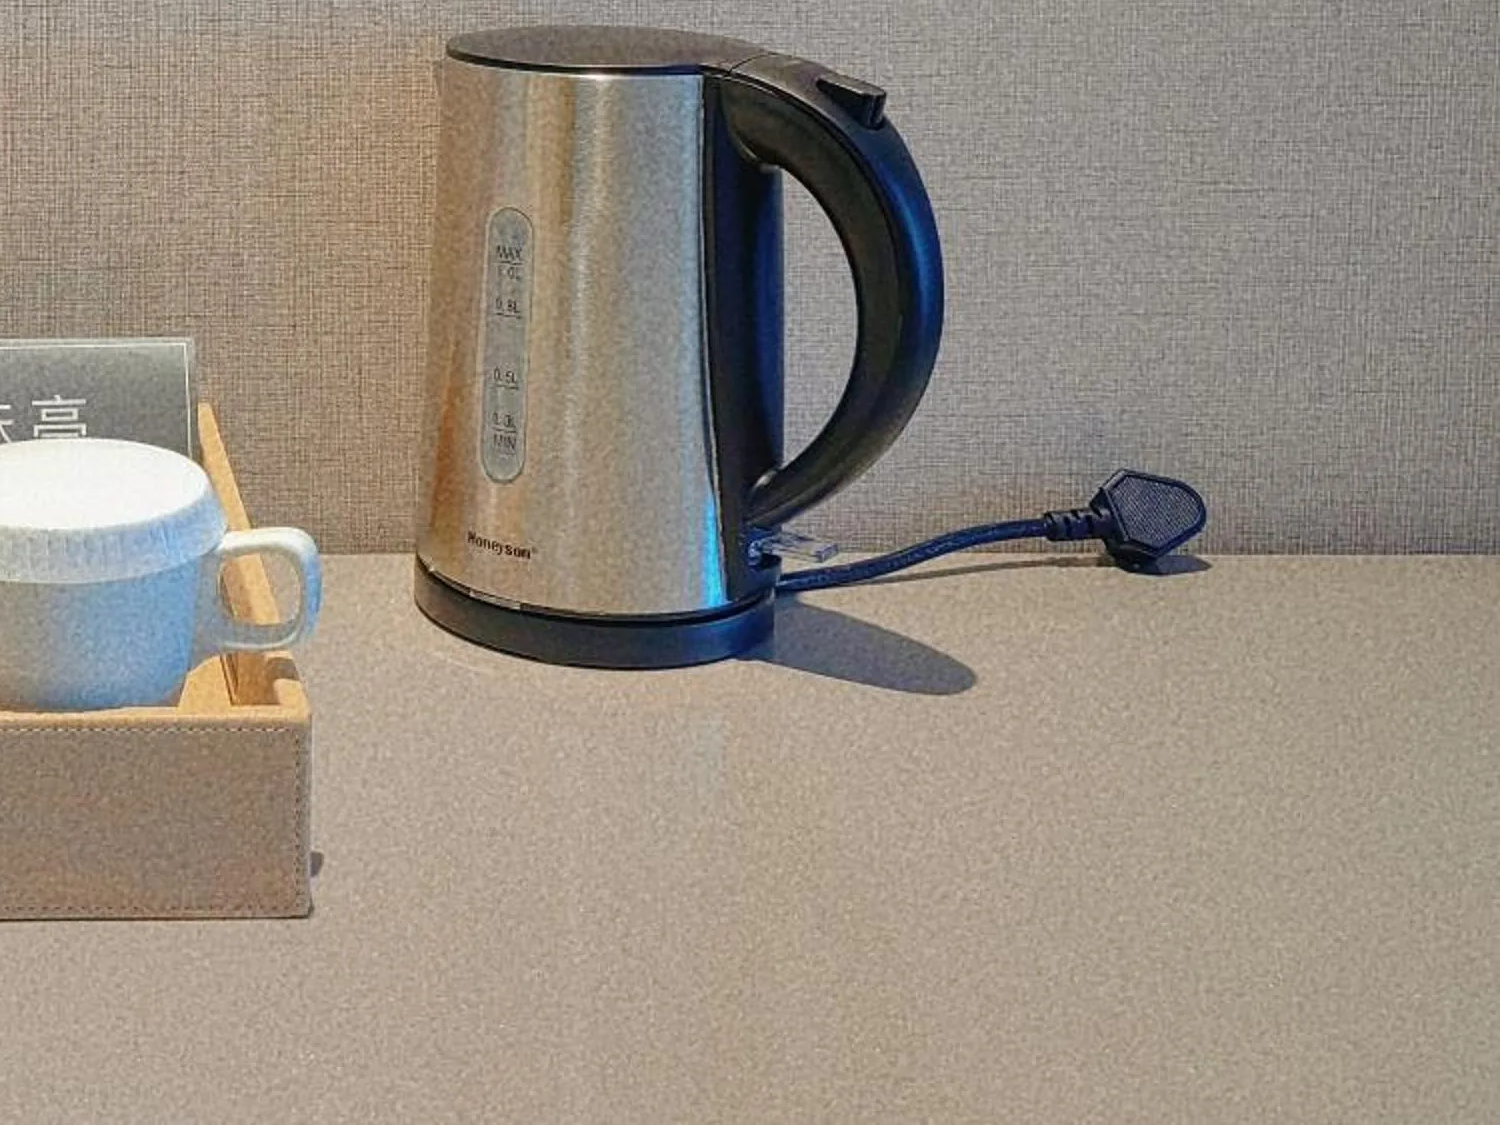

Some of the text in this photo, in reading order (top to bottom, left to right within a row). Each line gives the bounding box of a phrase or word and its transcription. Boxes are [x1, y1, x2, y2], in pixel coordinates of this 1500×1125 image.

[496, 244, 524, 261] MAX
[493, 434, 518, 451] MIN
[466, 530, 532, 560] Honeyson
